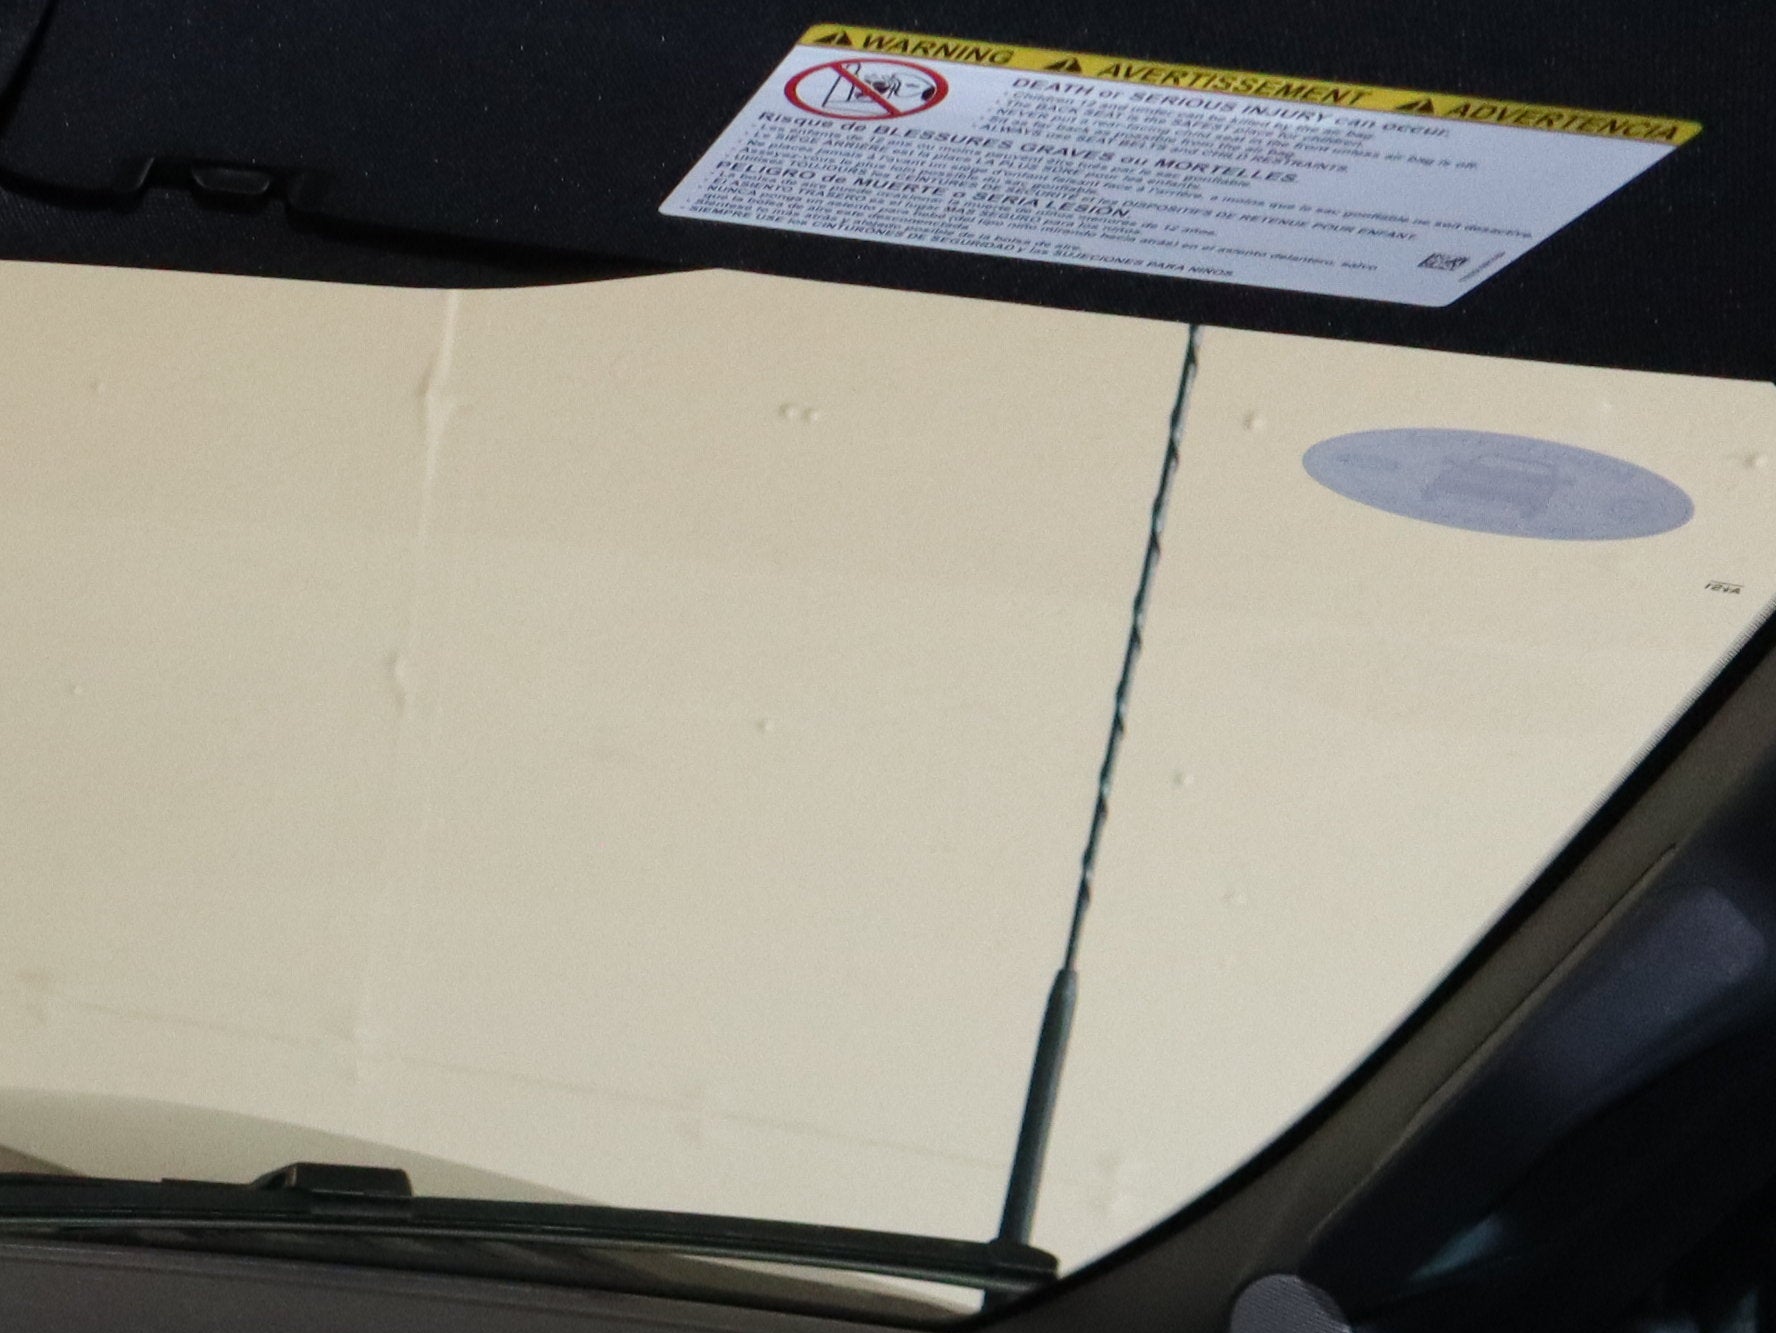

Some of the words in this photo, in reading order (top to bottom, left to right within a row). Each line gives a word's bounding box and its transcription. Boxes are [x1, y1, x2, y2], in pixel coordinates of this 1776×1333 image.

[863, 33, 1014, 64] WARNING
[1012, 78, 1095, 96] DEATH
[1129, 91, 1236, 112] SERIOUS
[1242, 105, 1334, 122] INJURY
[1099, 63, 1373, 105] AVERTISSEMENT
[1450, 103, 1679, 140] ADVERTENCIA
[873, 125, 1015, 151] BLESSURES
[1019, 142, 1115, 162] GRAVES
[1154, 157, 1298, 183] MORTELLES
[716, 161, 816, 181] PELIGRO
[853, 177, 946, 198] MUERTE
[973, 192, 1039, 208] SERIA
